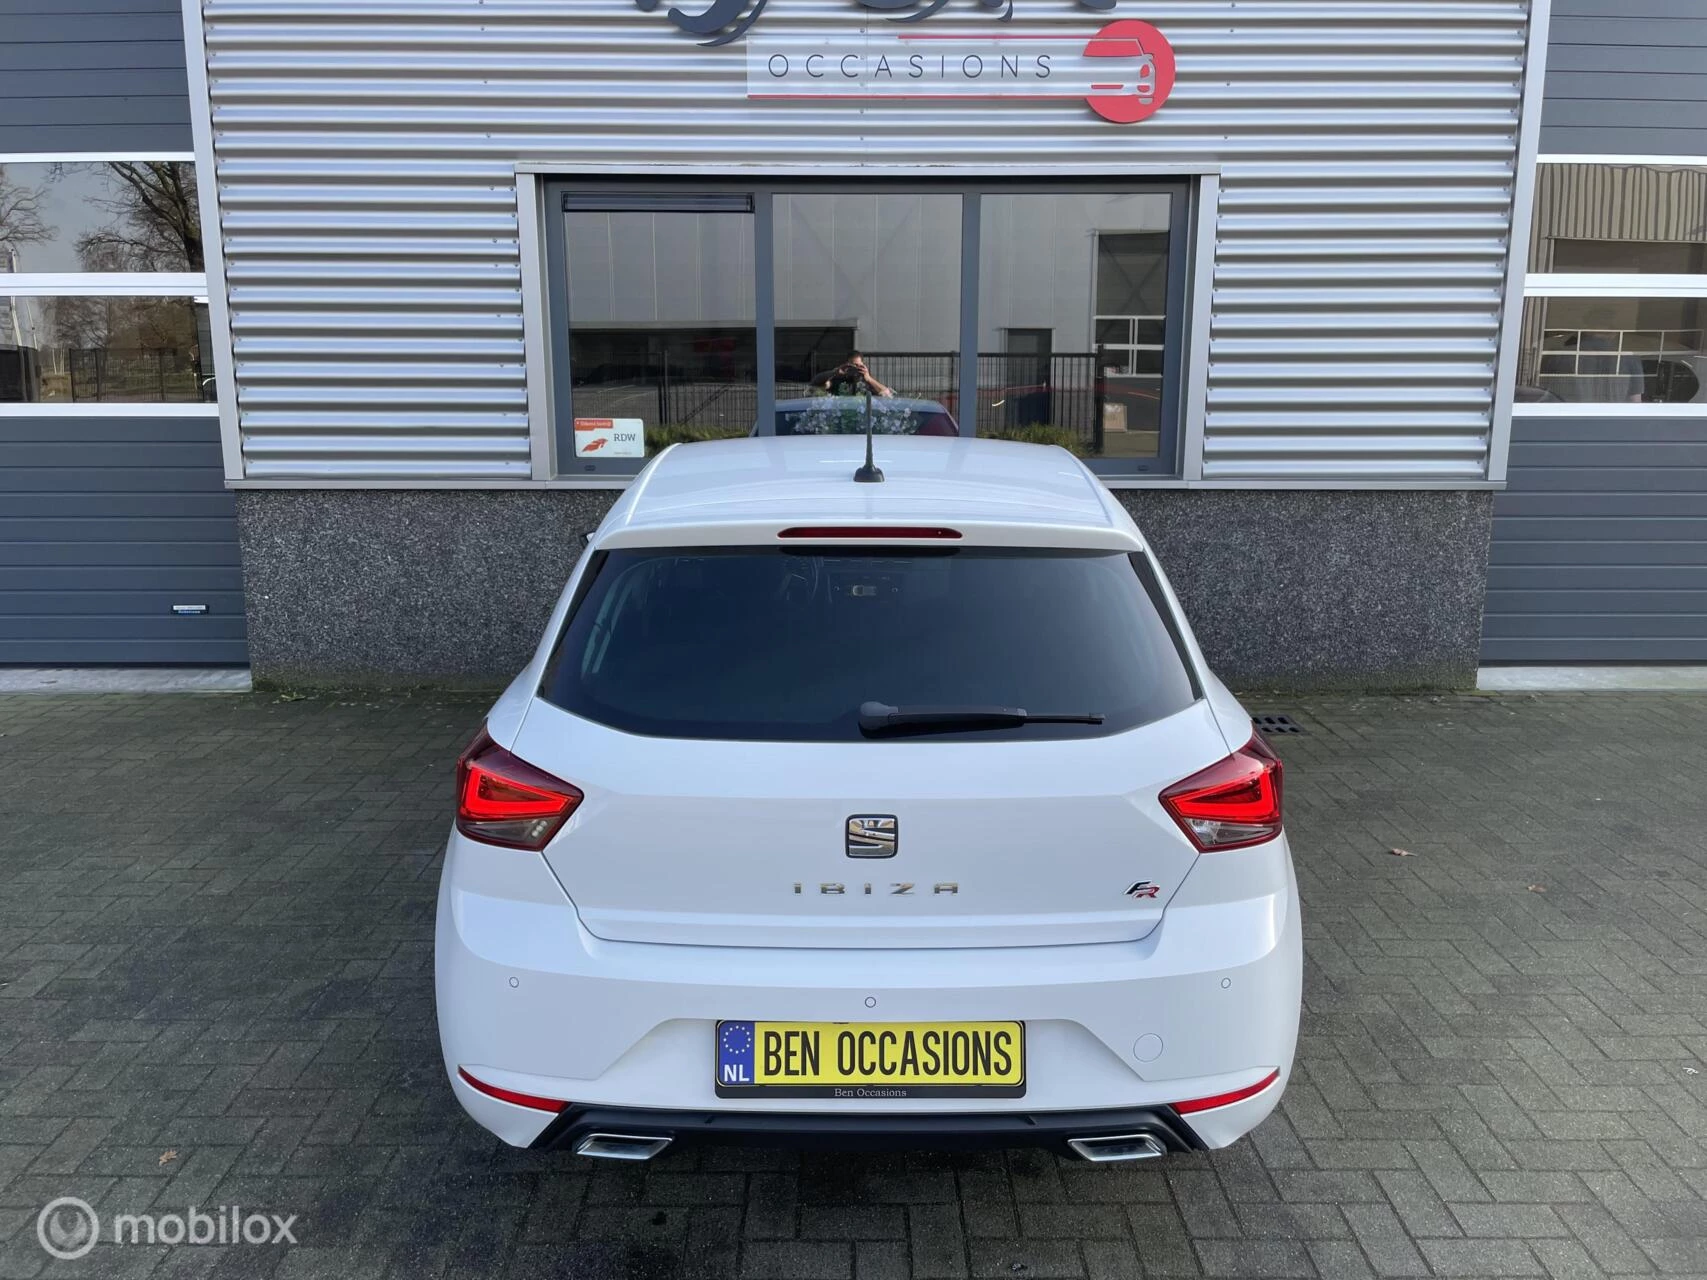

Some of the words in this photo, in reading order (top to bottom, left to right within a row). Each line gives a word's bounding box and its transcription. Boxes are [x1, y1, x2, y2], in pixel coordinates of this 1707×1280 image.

[767, 53, 1053, 79] OCCASIONS
[613, 433, 636, 442] RDW
[793, 882, 959, 895] IBIZA
[1124, 879, 1161, 898] FR
[763, 1030, 820, 1076] BEN
[837, 1030, 1012, 1077] OCCASIONS
[723, 1064, 750, 1082] NL
[834, 1088, 854, 1097] Ben
[856, 1088, 907, 1098] Occasions
